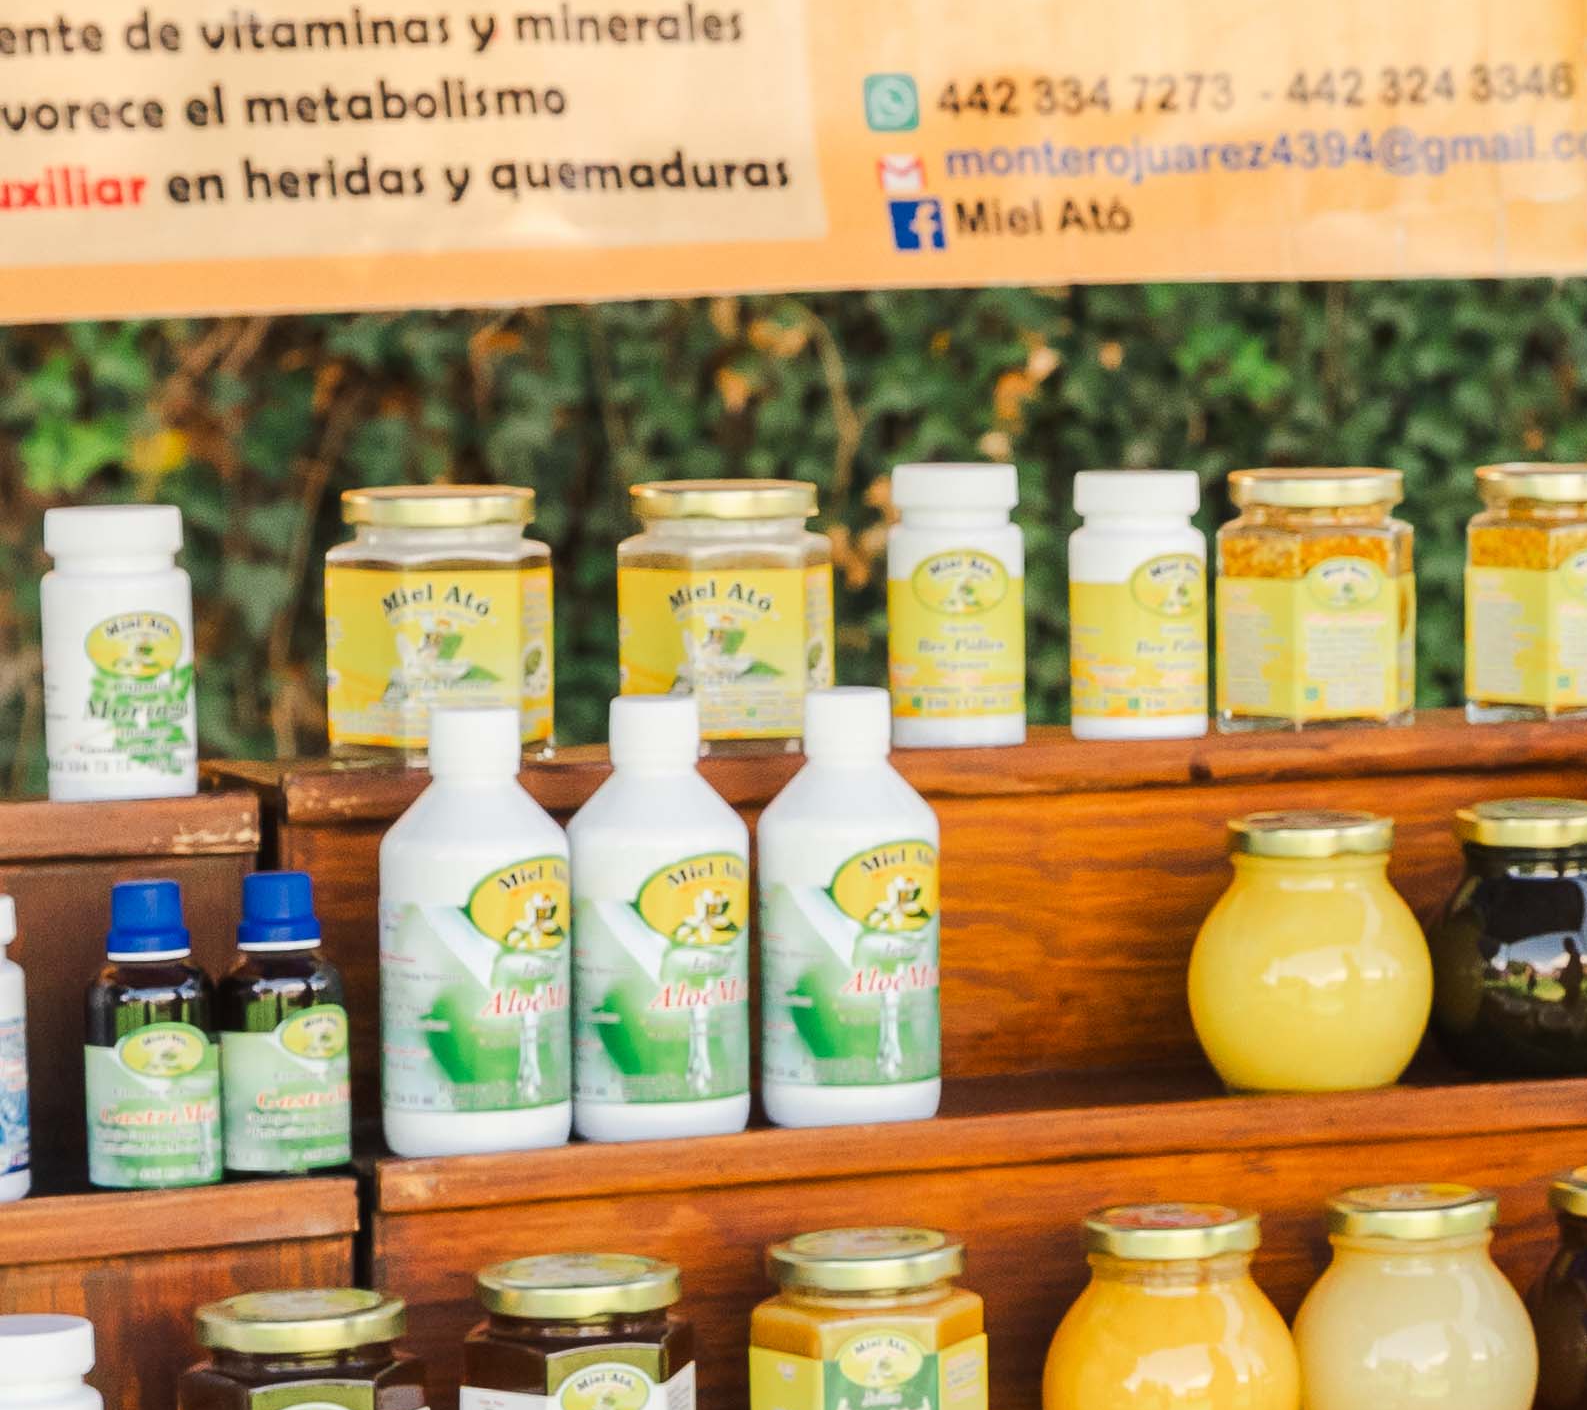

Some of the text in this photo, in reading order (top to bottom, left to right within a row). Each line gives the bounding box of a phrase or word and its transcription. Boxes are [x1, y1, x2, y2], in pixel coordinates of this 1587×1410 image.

[125, 10, 181, 54] de
[201, 7, 450, 52] vitaminas
[471, 15, 496, 53] y
[515, 2, 744, 45] minerales
[186, 86, 225, 128] el
[245, 79, 568, 127] metabolismo
[937, 64, 1575, 116] 442 334 7273 442 324 3346
[168, 169, 226, 205] en
[243, 158, 426, 202] heridas
[442, 164, 470, 204] y
[490, 151, 790, 199] quemaduras
[955, 197, 1134, 236] Miel Ató
[382, 582, 433, 615] Miel
[667, 579, 717, 613] Miel
